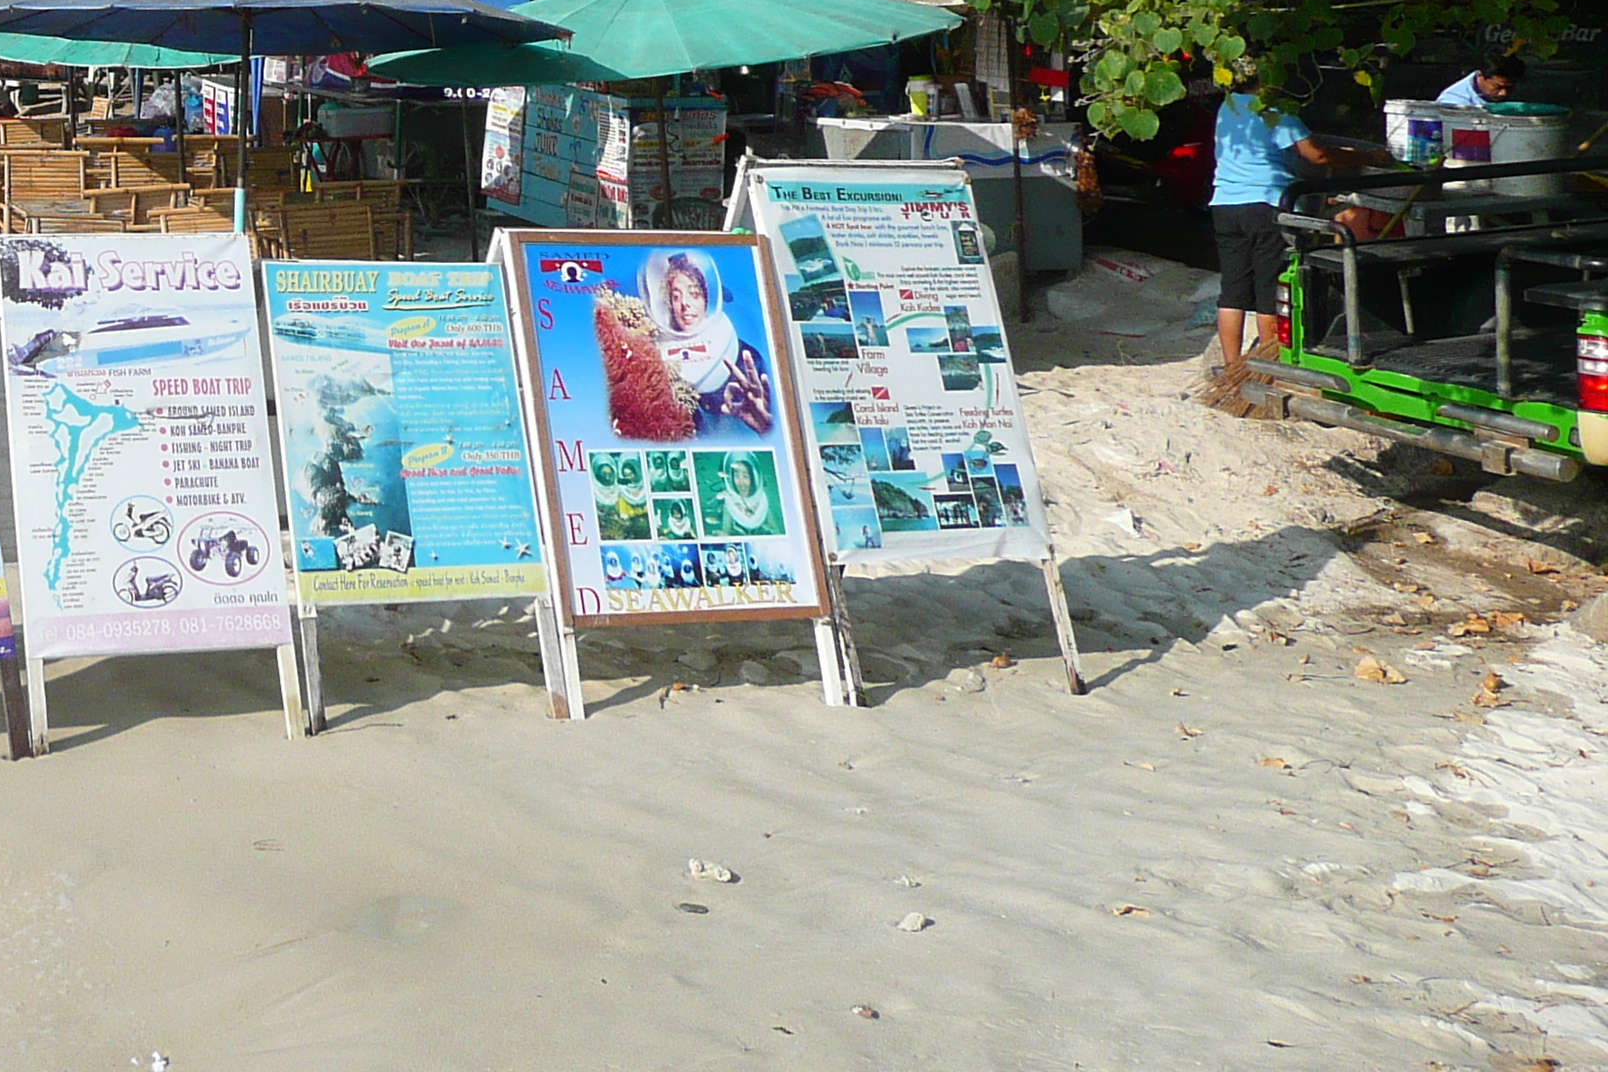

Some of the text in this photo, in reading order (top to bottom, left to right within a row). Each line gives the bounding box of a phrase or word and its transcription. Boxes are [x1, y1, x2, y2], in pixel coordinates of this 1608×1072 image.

[1561, 23, 1603, 43] Bar
[899, 201, 969, 212] JIMMY'S
[539, 251, 610, 261] SAMED
[17, 248, 241, 292] Kai Service
[275, 270, 381, 294] SHAIRBUAY
[387, 290, 421, 306] Speed
[914, 291, 939, 302] Diving
[446, 323, 465, 334] Only
[860, 348, 885, 359] Farm
[128, 368, 151, 376] FARM
[856, 362, 888, 376] Village
[152, 377, 252, 396] SPEED BOAT TRIP
[167, 405, 199, 417] AROUND
[227, 405, 255, 416] ISLAND
[853, 402, 899, 412] Coral Island
[958, 407, 1013, 417] Feeding Turtles
[856, 415, 872, 424] Koh
[962, 418, 978, 428] Koh
[170, 425, 187, 436] KOH
[171, 440, 252, 454] FISHING NIGHT TRIP
[461, 452, 484, 462] Only
[172, 457, 259, 472] JET SKI BANANA BOAT
[174, 476, 218, 489] PARACHUTE
[176, 493, 247, 506] MOTORBIKE ATV.
[312, 575, 339, 591] Contact
[339, 575, 357, 590] Here
[357, 574, 370, 588] For
[369, 573, 408, 588] Reservation
[607, 579, 798, 613] SEAWALKER
[179, 612, 282, 635] 081-7628668
